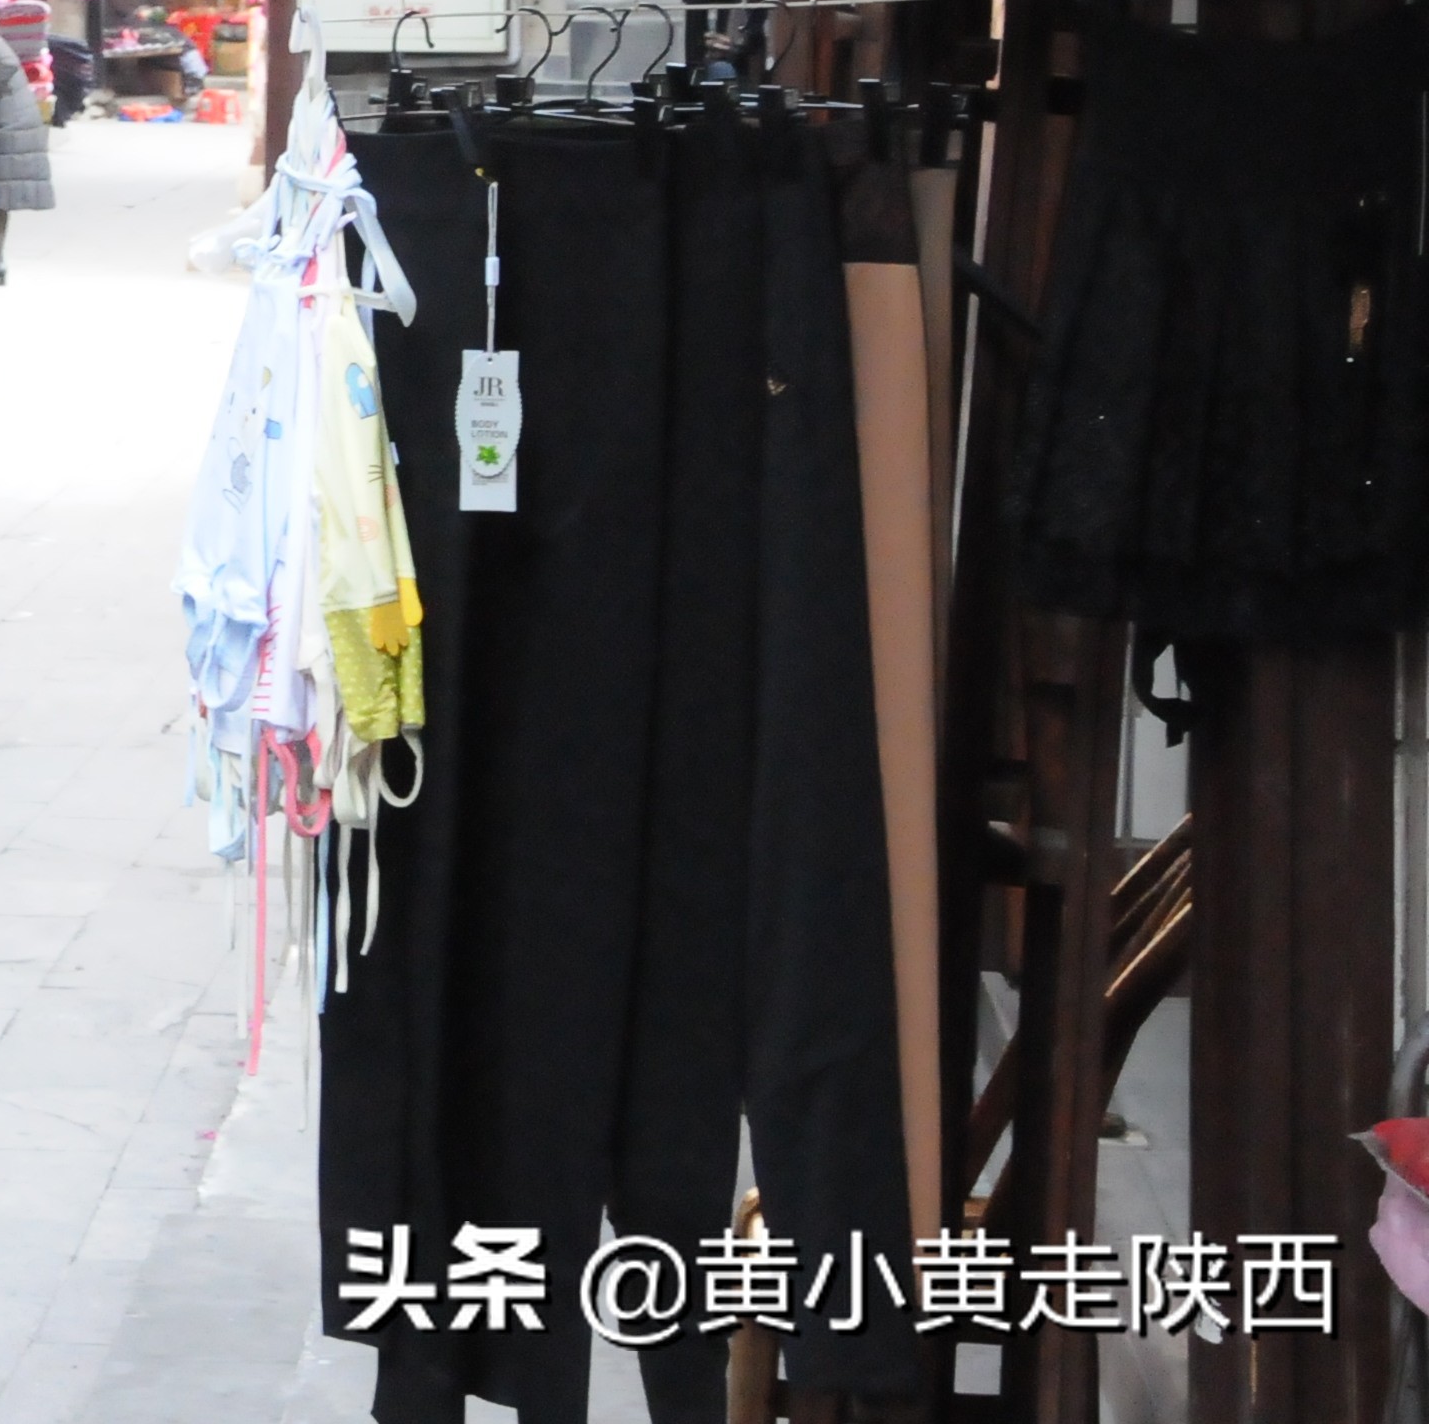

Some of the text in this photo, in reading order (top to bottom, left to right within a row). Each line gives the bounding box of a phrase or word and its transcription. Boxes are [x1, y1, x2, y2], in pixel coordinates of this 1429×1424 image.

[473, 377, 504, 397] JR
[471, 420, 498, 428] BODY
[471, 430, 508, 438] LOTION
